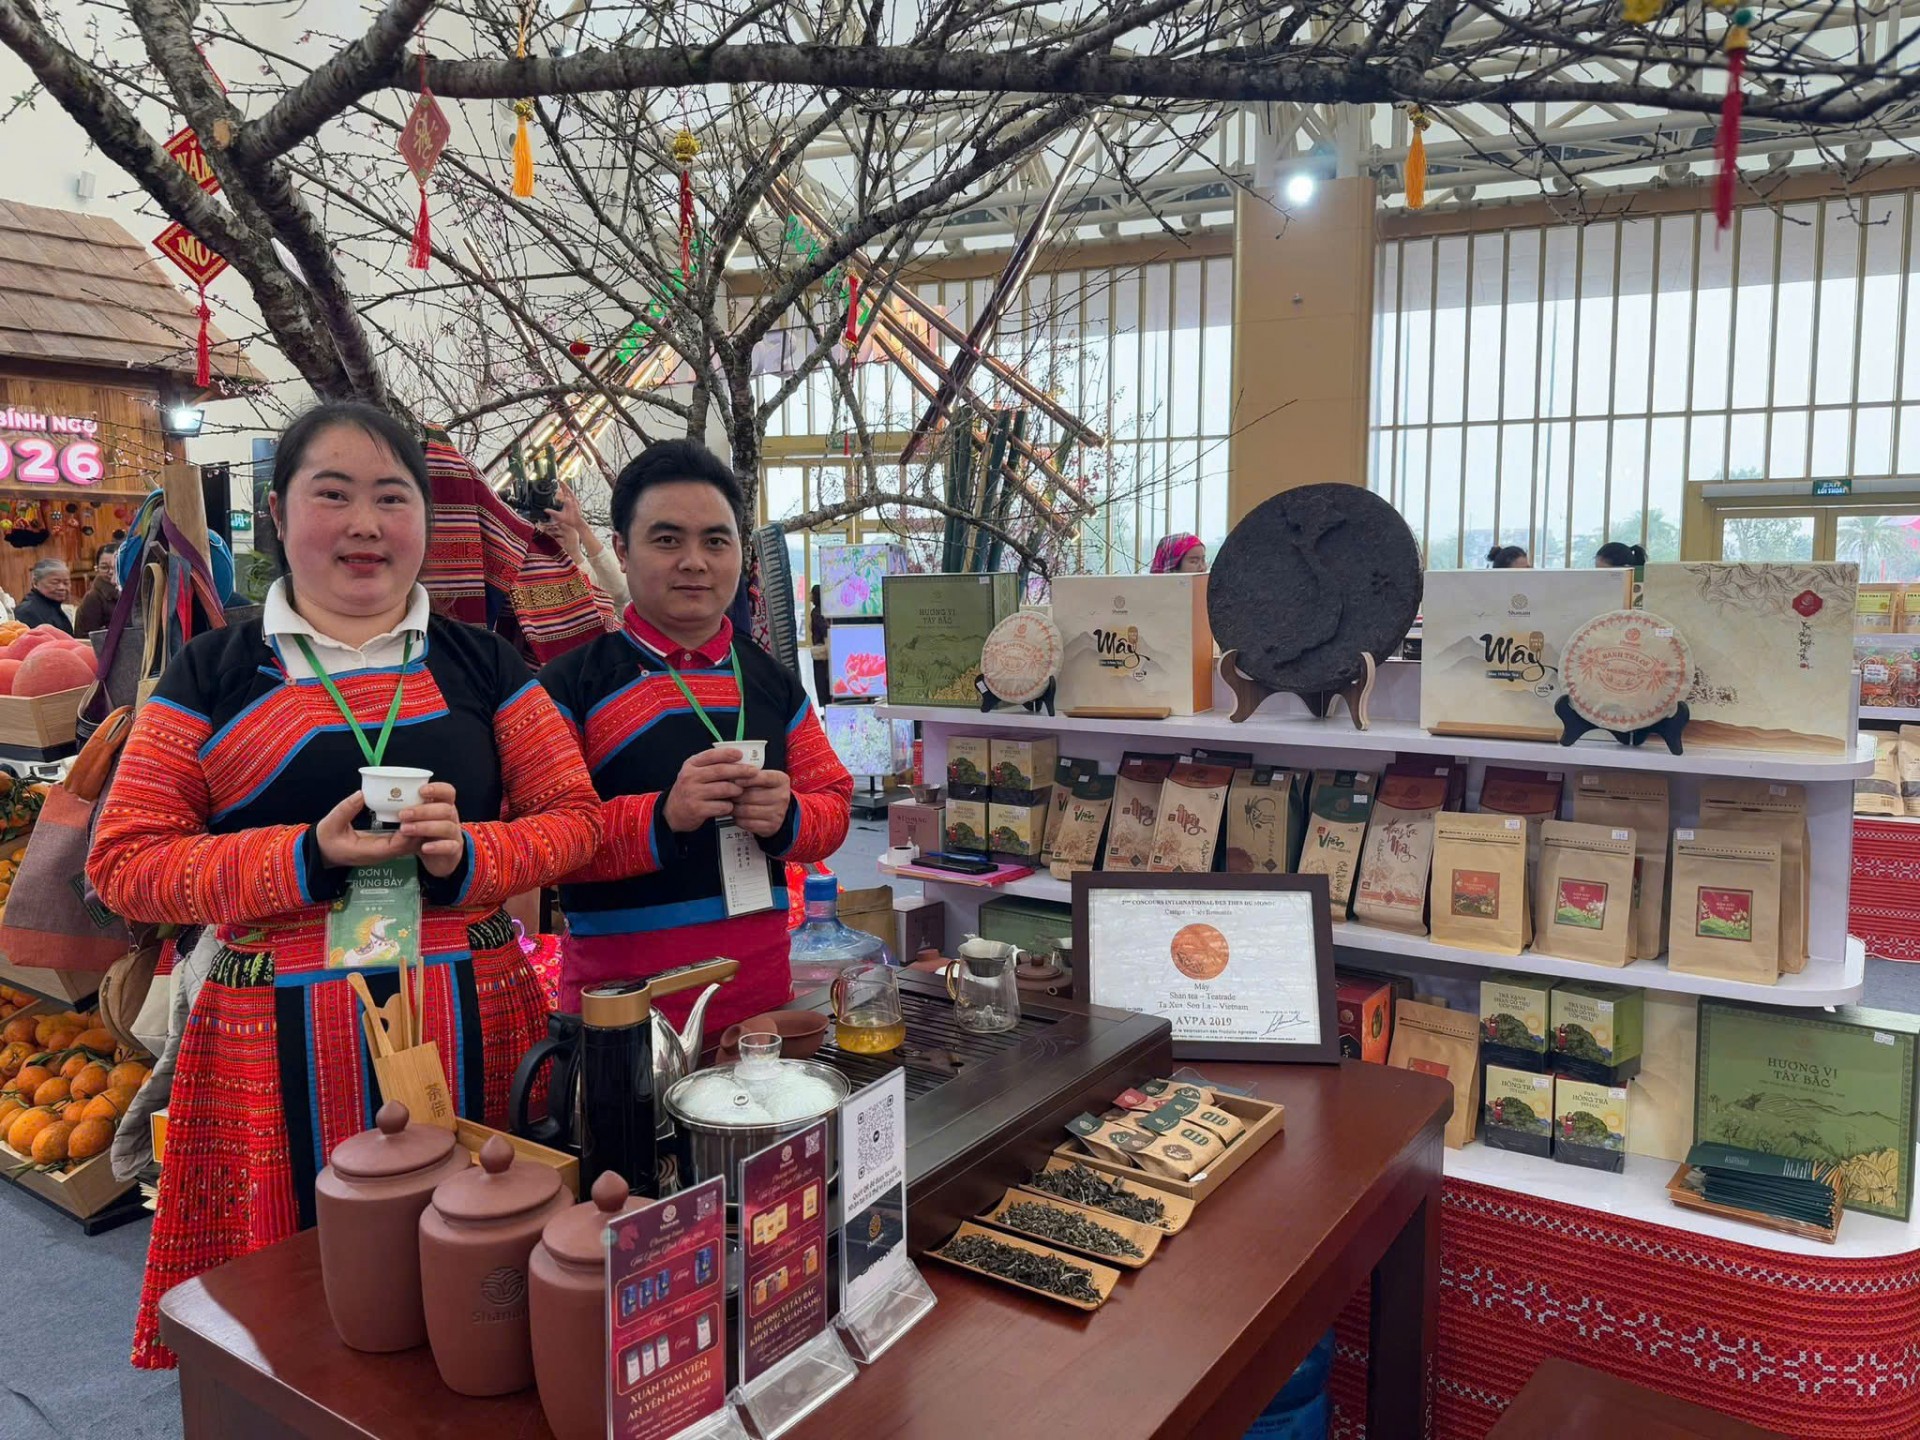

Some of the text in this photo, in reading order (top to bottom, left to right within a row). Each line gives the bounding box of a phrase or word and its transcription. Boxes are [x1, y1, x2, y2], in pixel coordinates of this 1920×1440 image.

[1480, 633, 1559, 682] Mây
[358, 868, 393, 879] ĐƠN VỊ
[383, 877, 404, 887] BÀY
[1169, 992, 1187, 1000] Shan
[1207, 993, 1236, 1001] Teatrade
[1219, 1003, 1249, 1011] Vietnam
[1175, 1016, 1232, 1027] AVPA 2019
[1768, 1057, 1838, 1081] HƯƠNG VỊ
[1773, 1069, 1799, 1083] TÂY
[1803, 1075, 1832, 1089] BẮC
[630, 1356, 709, 1406] XUÂN TAM VIÊN
[627, 1370, 712, 1424] AN YÊN NĂM MỚI
